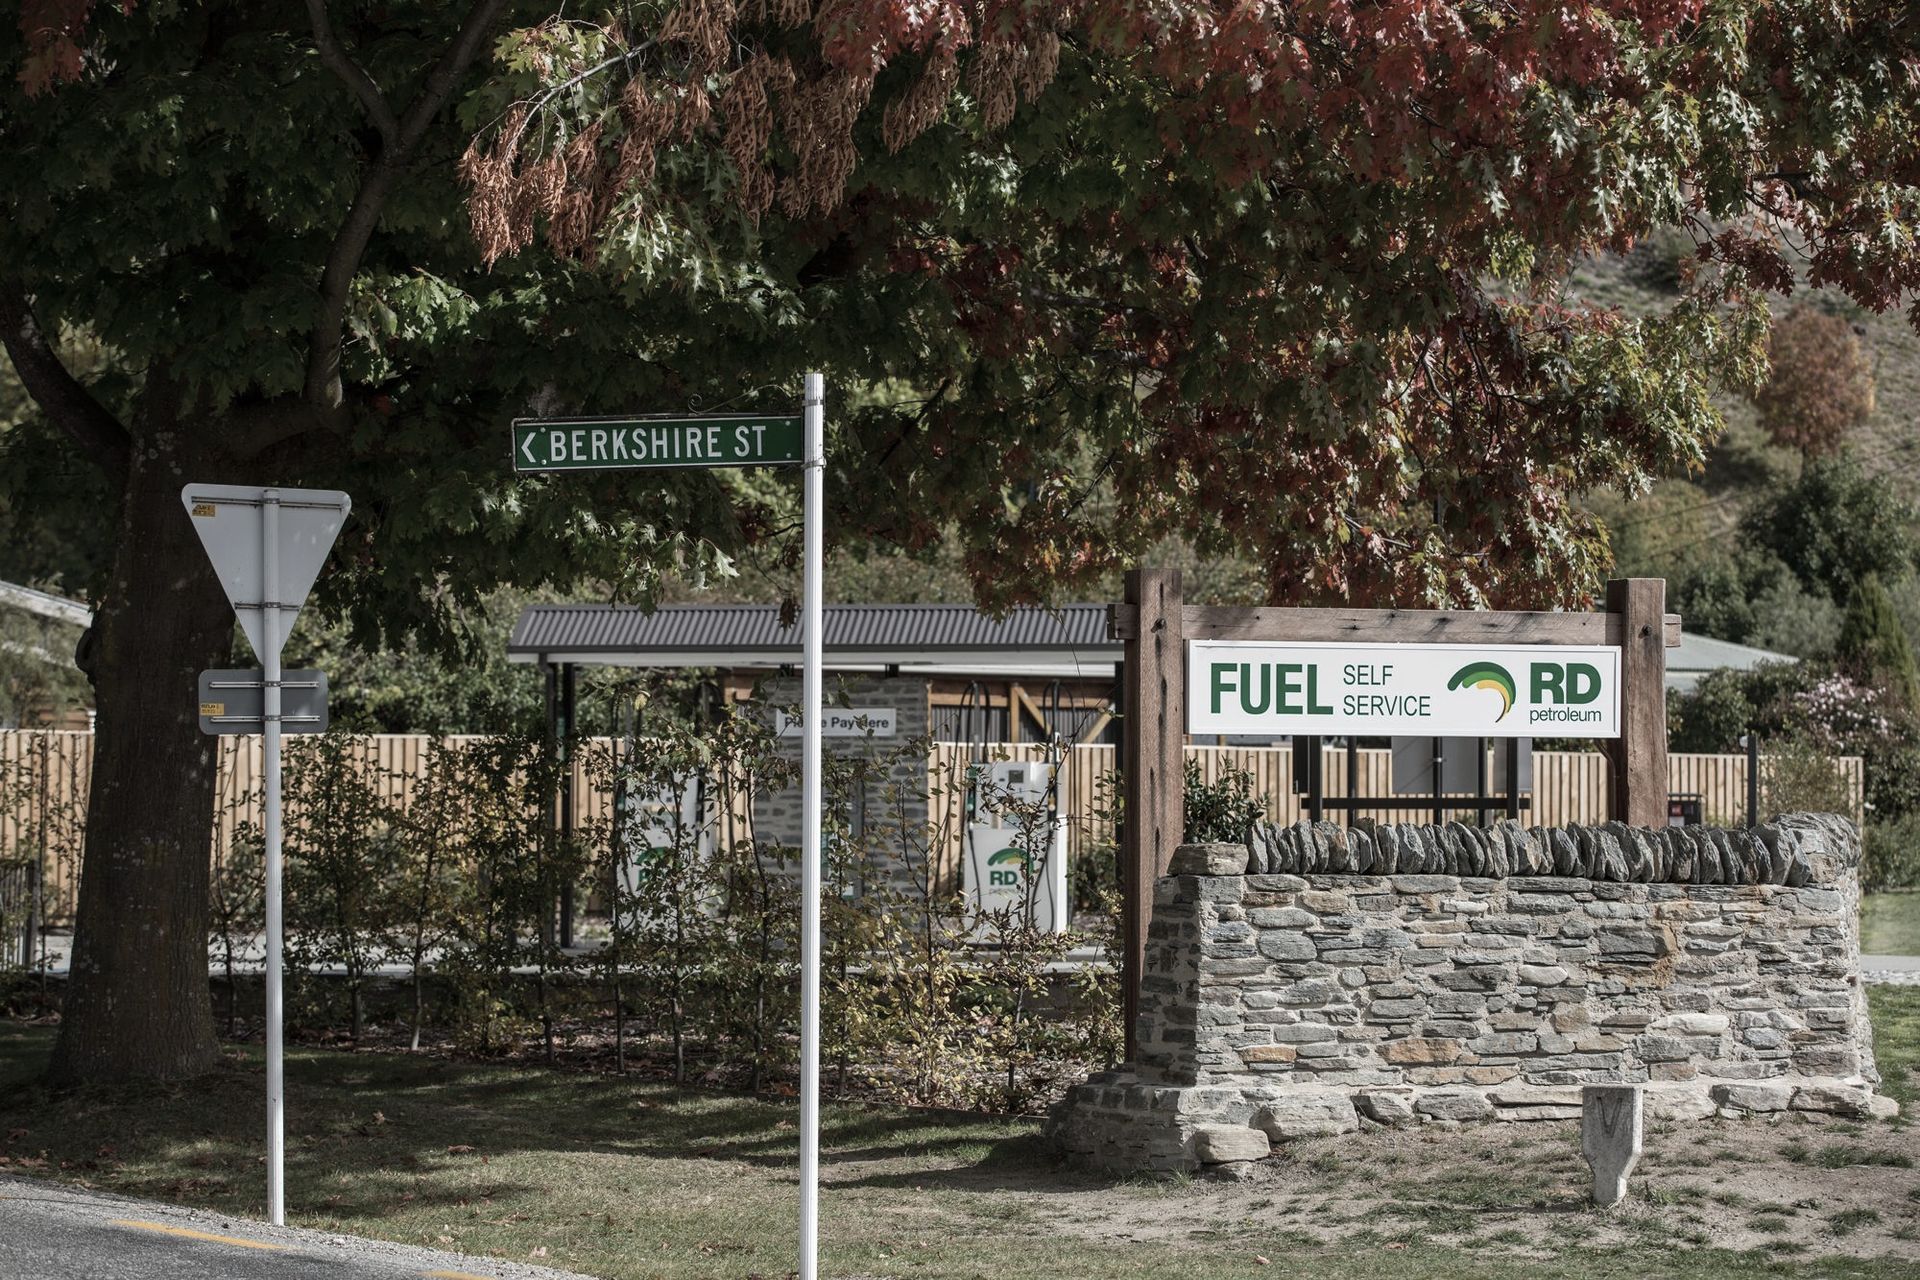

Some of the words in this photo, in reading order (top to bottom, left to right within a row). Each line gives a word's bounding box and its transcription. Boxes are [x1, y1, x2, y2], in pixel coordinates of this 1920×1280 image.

[551, 426, 722, 462] BERKSHIRE
[734, 425, 766, 457] ST
[1343, 664, 1394, 685] SELF
[1530, 662, 1602, 704] RD
[1210, 662, 1334, 715] FUEL
[1343, 694, 1431, 716] SERVICE
[831, 716, 855, 730] Pay
[1530, 707, 1602, 725] petroleum
[990, 870, 1018, 885] RD
